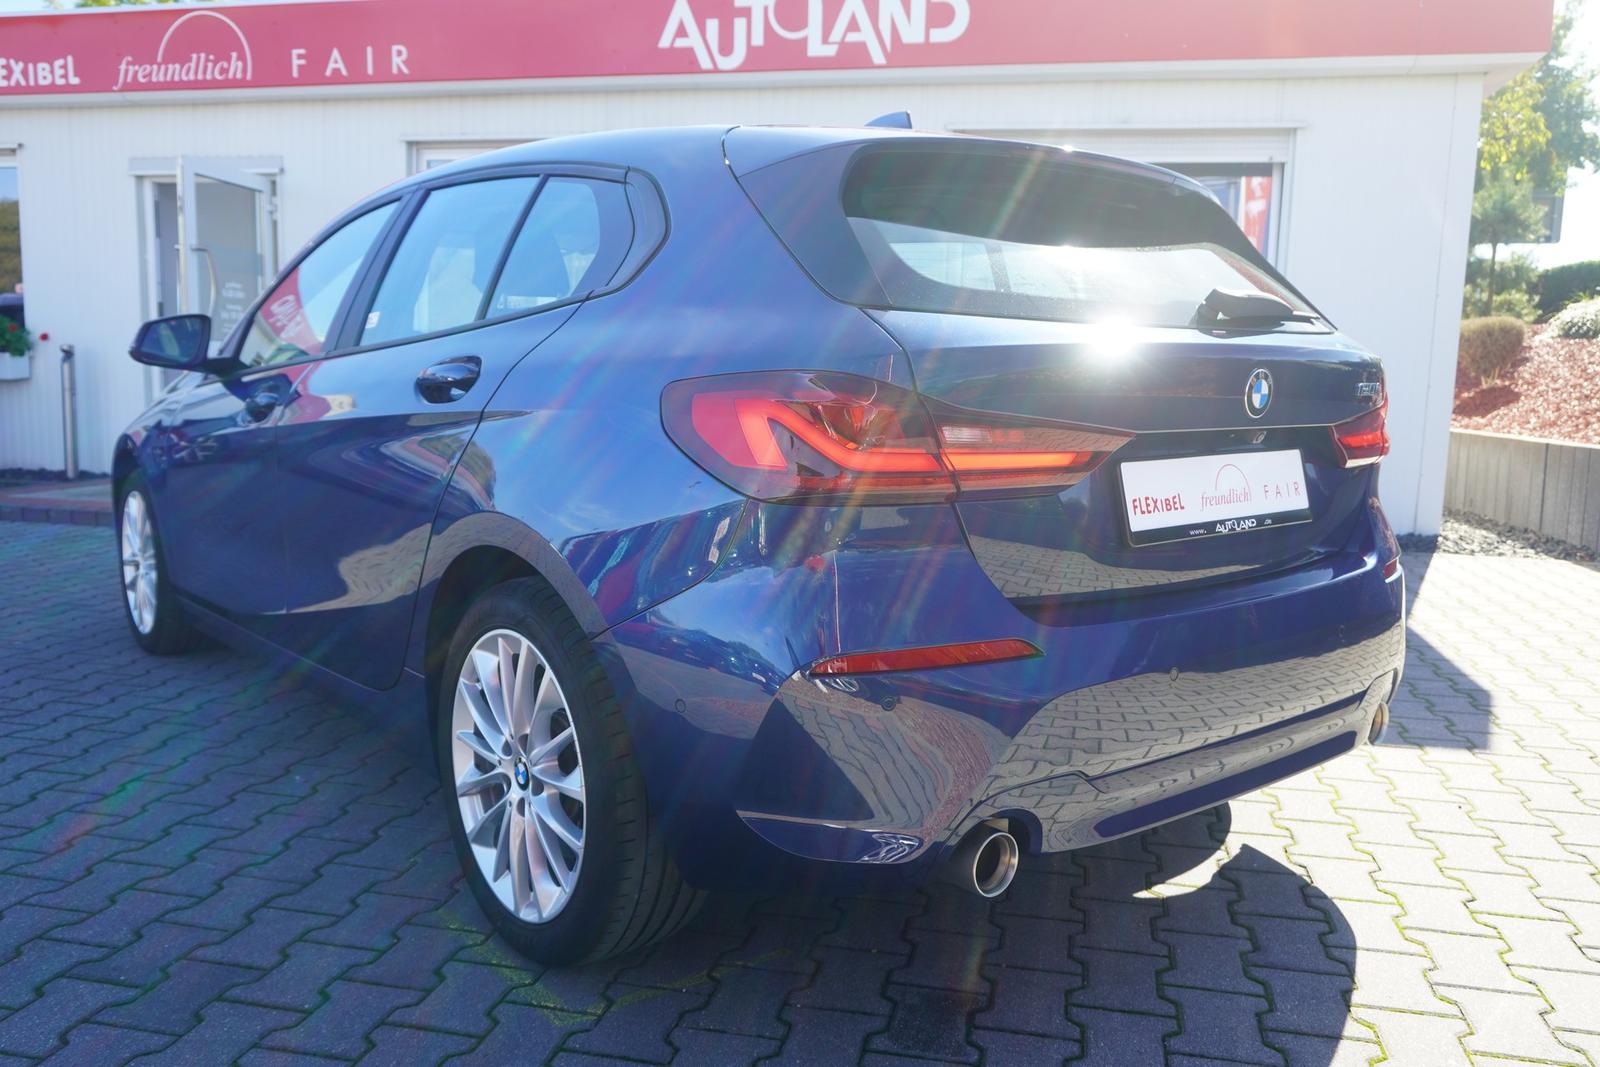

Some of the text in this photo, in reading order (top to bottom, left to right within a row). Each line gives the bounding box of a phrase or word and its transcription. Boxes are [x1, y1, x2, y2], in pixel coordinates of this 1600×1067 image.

[112, 52, 244, 91] freundlich
[1132, 481, 1301, 516] FLEXIBEL freundlich FAIR
[1215, 518, 1257, 534] AUTOLAND
